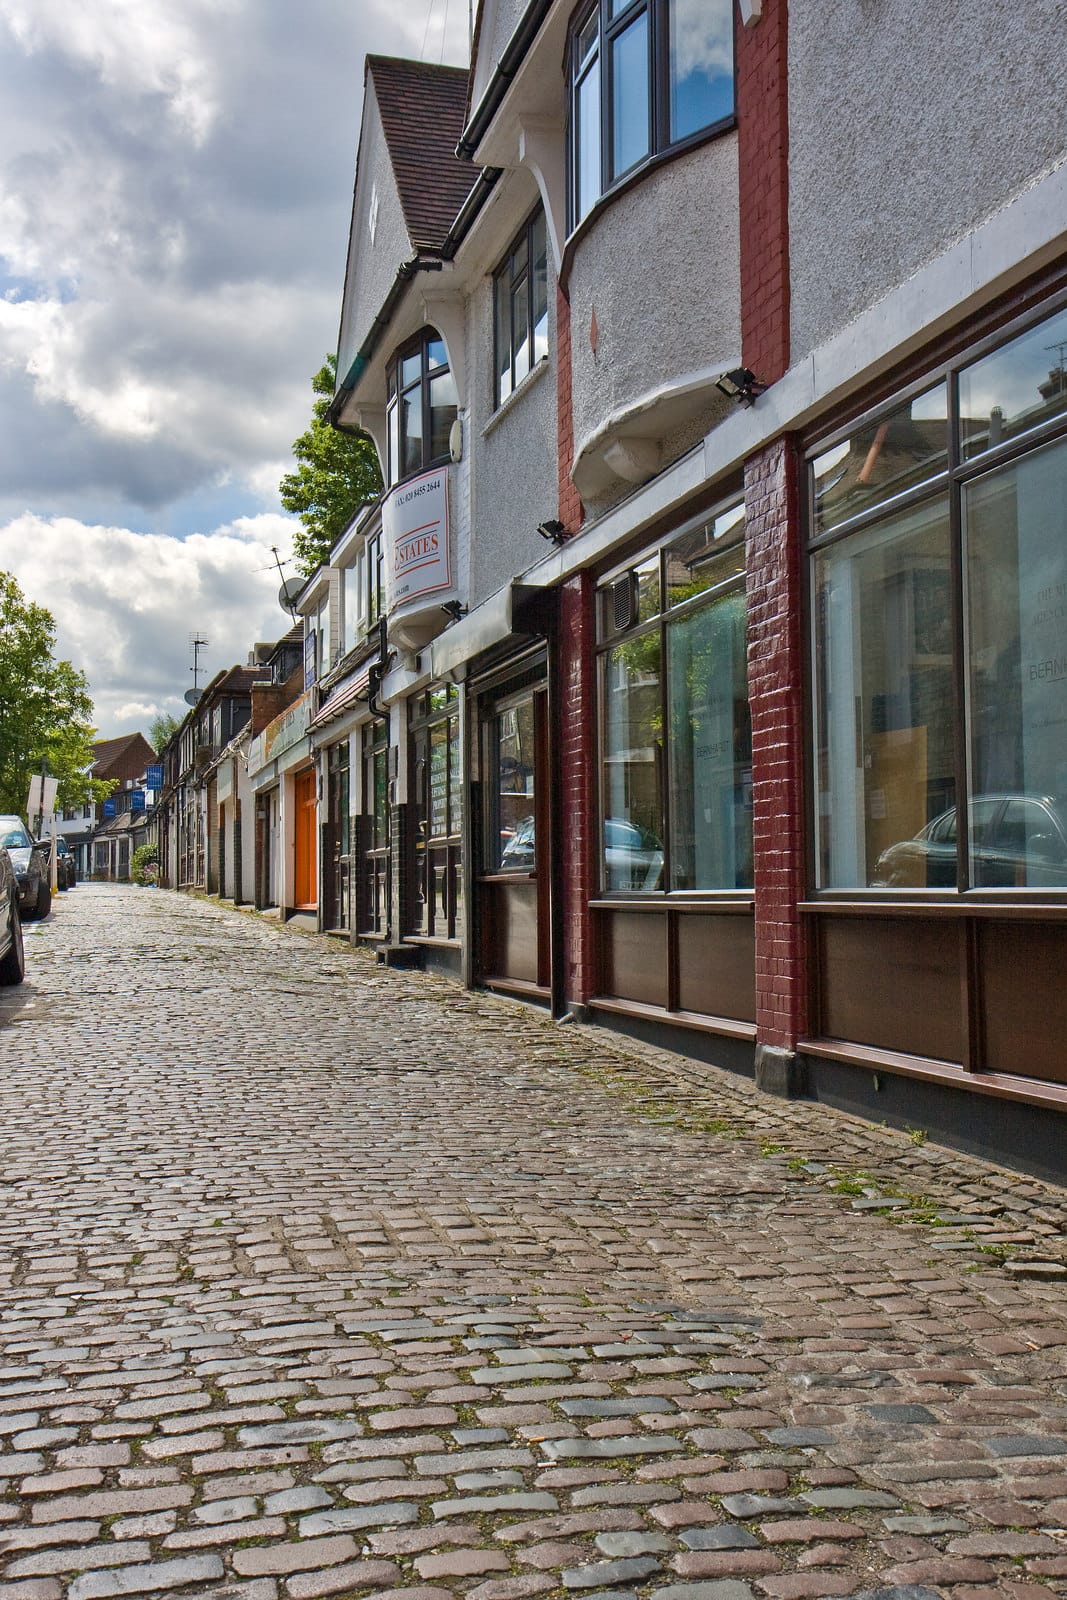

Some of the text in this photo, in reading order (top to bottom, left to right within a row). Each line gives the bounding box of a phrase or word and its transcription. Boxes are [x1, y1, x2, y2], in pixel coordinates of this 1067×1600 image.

[414, 485, 426, 498] 8455
[427, 480, 440, 492] 2644
[394, 533, 439, 571] ESTATES
